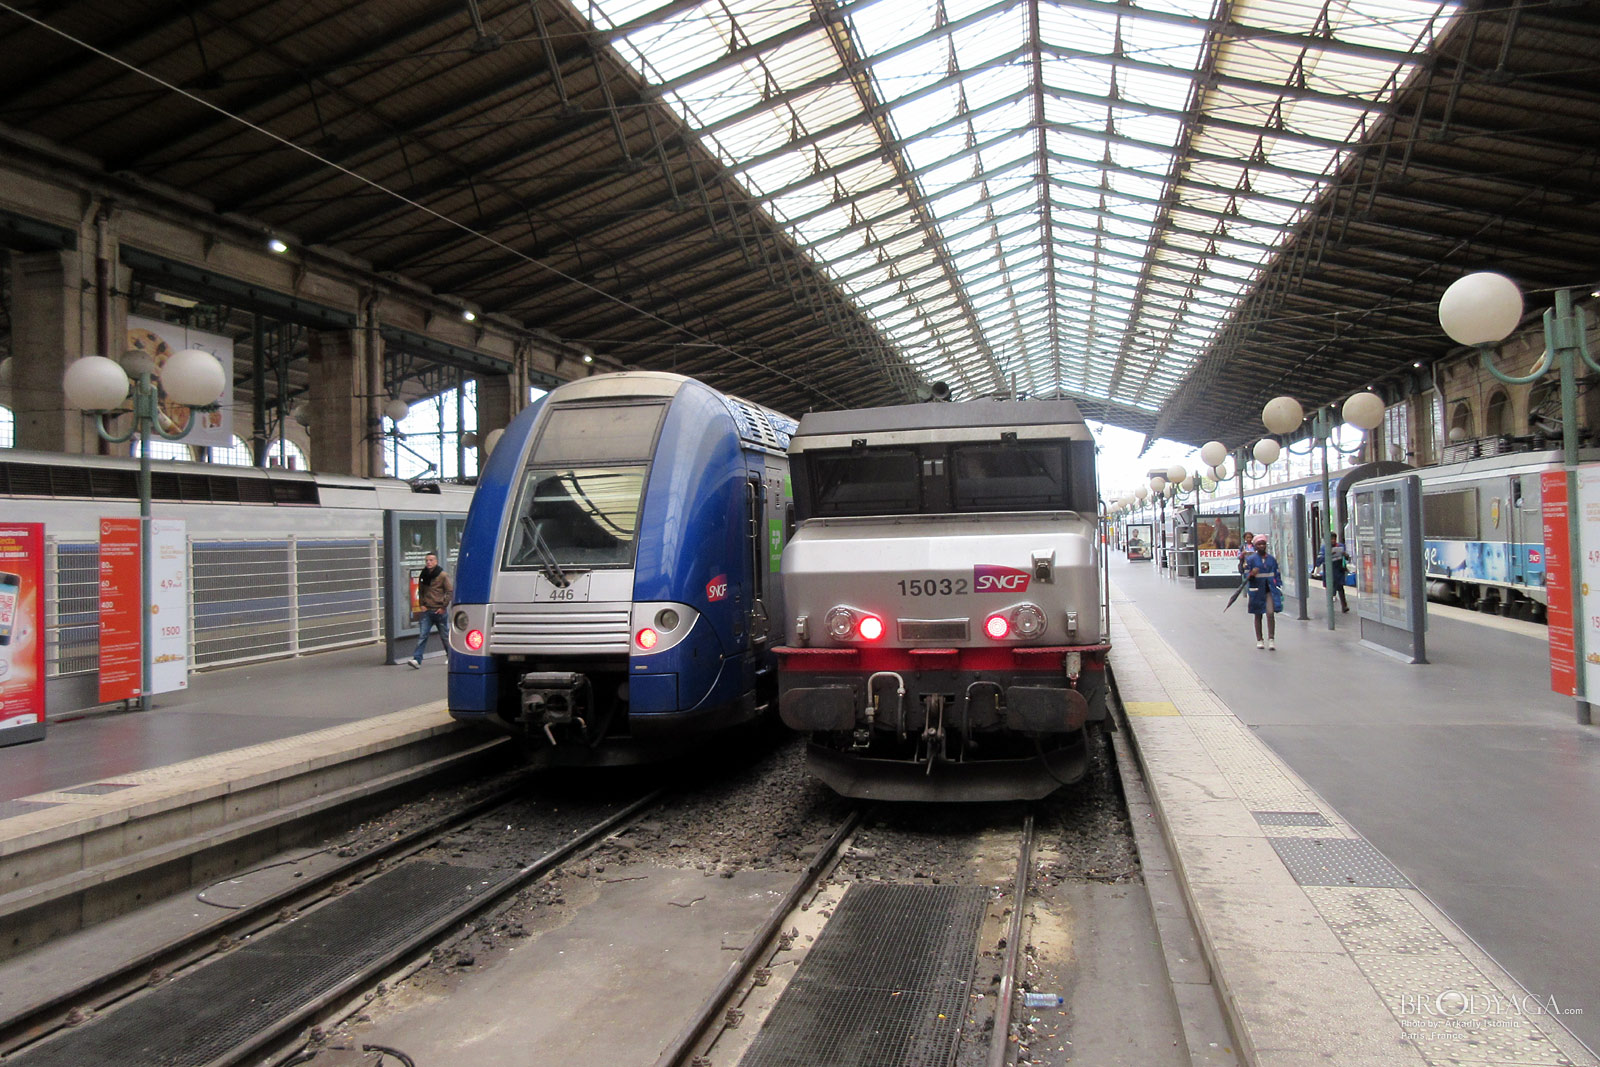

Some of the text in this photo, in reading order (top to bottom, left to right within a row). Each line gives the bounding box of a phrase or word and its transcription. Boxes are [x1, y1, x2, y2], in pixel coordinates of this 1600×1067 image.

[898, 579, 968, 596] 15032
[976, 574, 1028, 589] SNCF
[550, 589, 574, 600] 446
[708, 583, 728, 599] SNCF
[161, 626, 181, 636] 1500
